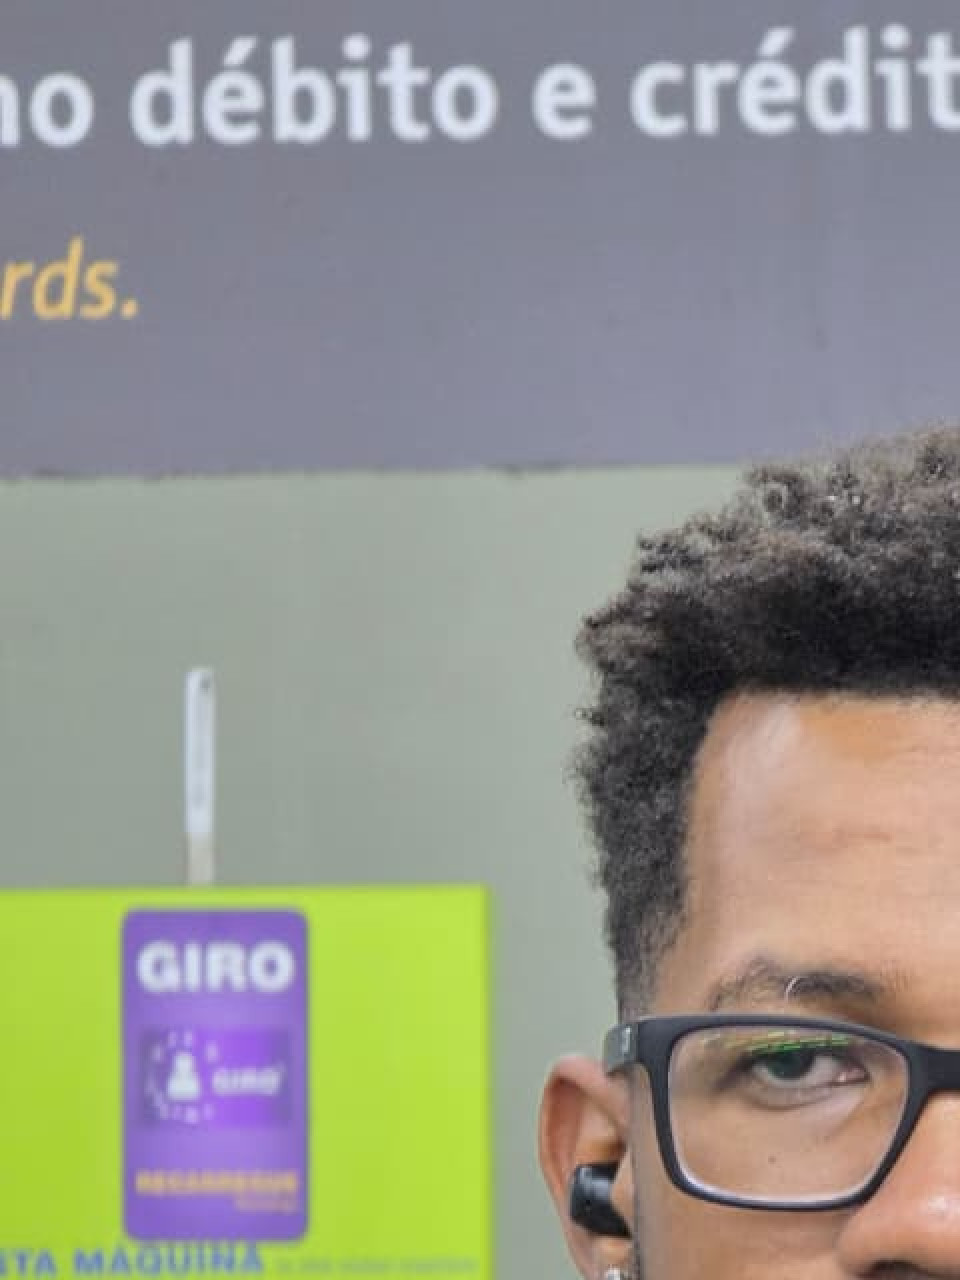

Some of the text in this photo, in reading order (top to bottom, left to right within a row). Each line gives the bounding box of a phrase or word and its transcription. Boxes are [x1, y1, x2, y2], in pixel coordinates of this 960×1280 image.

[130, 36, 499, 146] débito
[531, 62, 597, 138] e
[0, 236, 139, 320] rds.
[136, 940, 295, 993] GIRO
